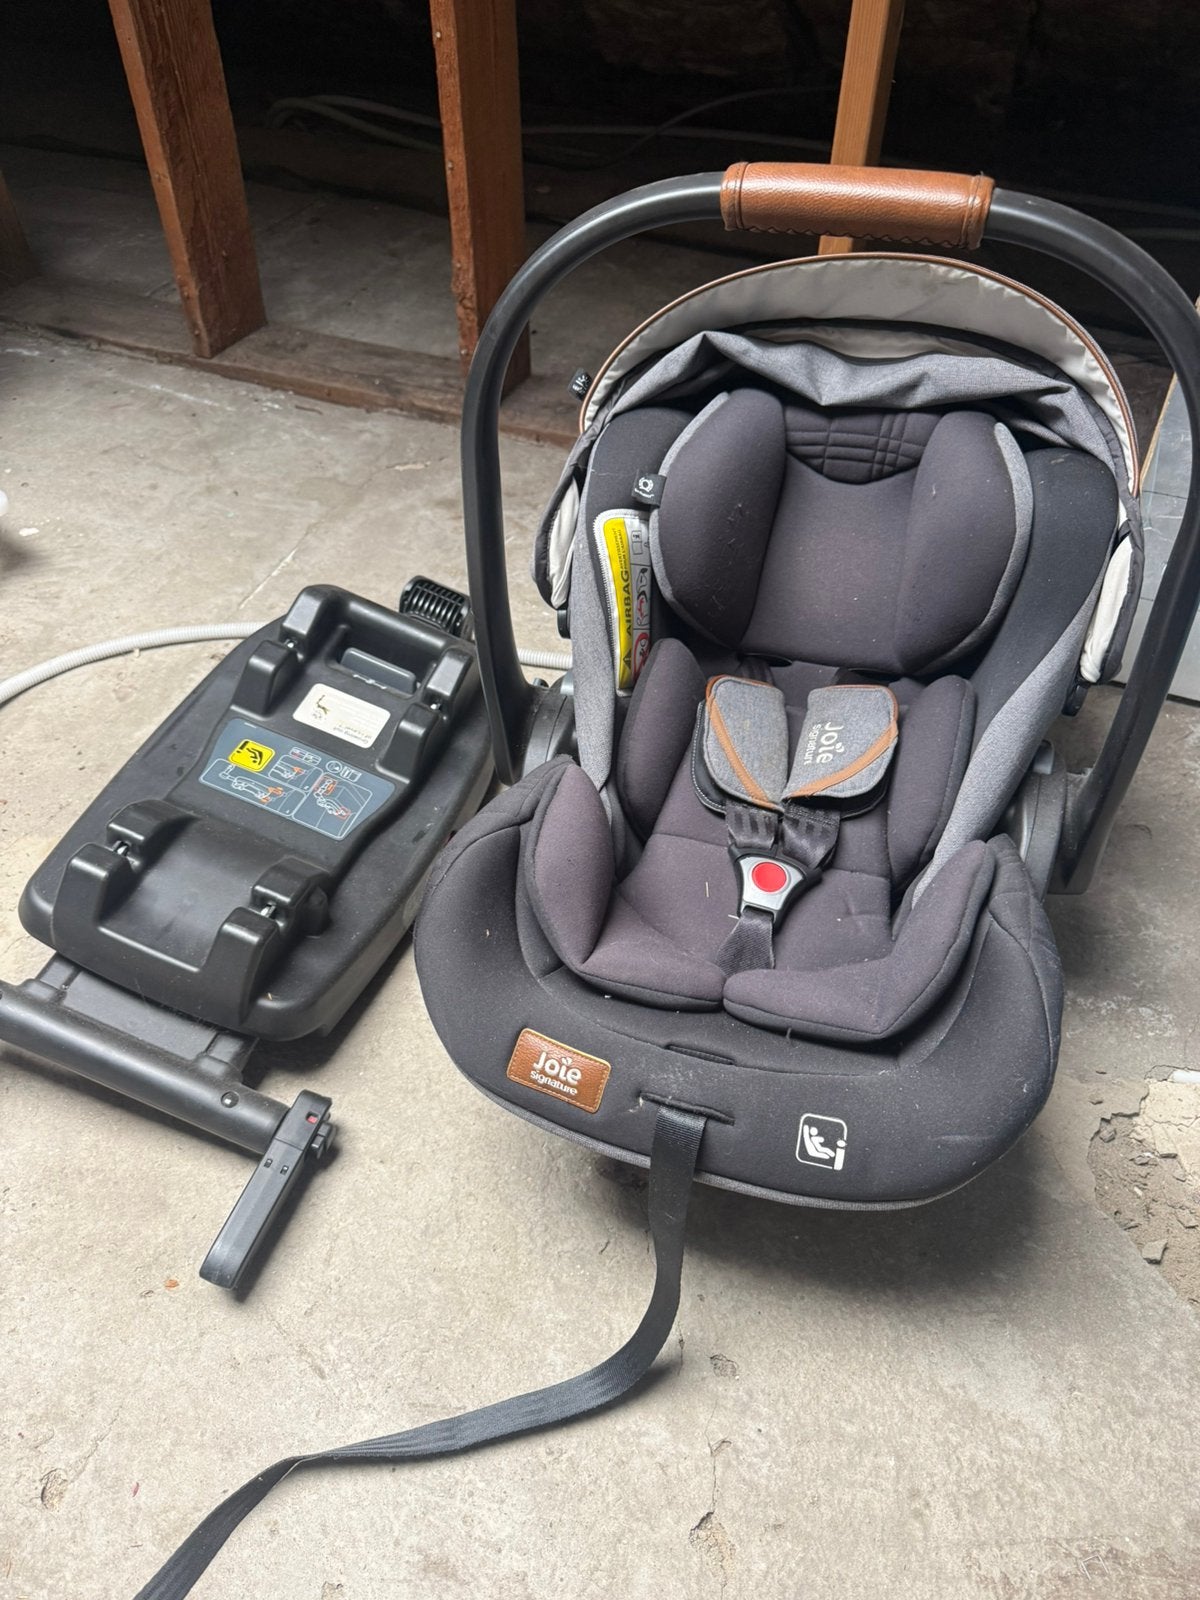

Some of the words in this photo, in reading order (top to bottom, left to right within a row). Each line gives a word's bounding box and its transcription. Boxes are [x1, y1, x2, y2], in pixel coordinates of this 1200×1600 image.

[620, 570, 632, 636] AIRBAG
[816, 721, 845, 764] Joie
[530, 1070, 578, 1096] signature
[533, 1051, 582, 1085] Joie
